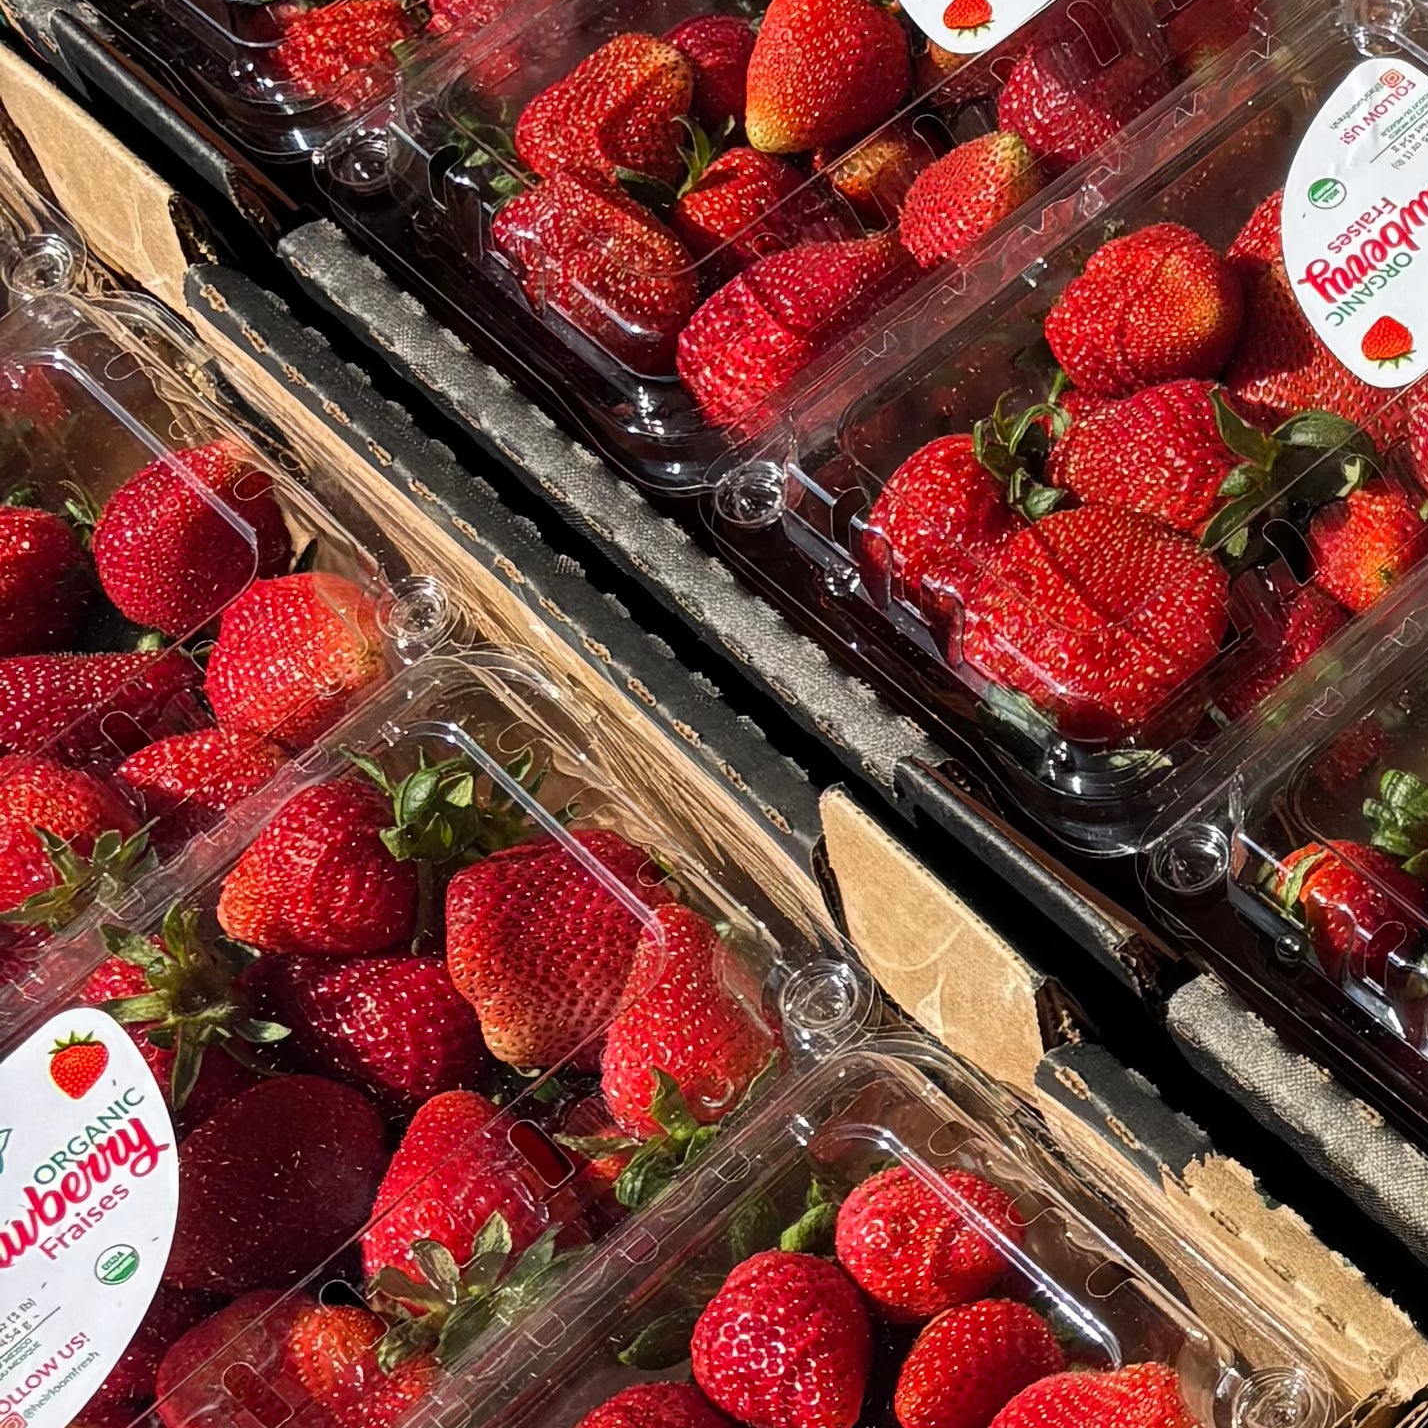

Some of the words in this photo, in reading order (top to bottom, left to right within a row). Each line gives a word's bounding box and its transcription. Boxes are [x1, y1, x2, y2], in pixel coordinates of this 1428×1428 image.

[1327, 195, 1398, 253] Fraises
[1325, 252, 1412, 327] ORGANIC
[33, 1086, 146, 1184] ORGANIC
[37, 1184, 129, 1261] Fraises
[56, 1330, 91, 1361] US!
[22, 1351, 101, 1420] @heirloomfresh
